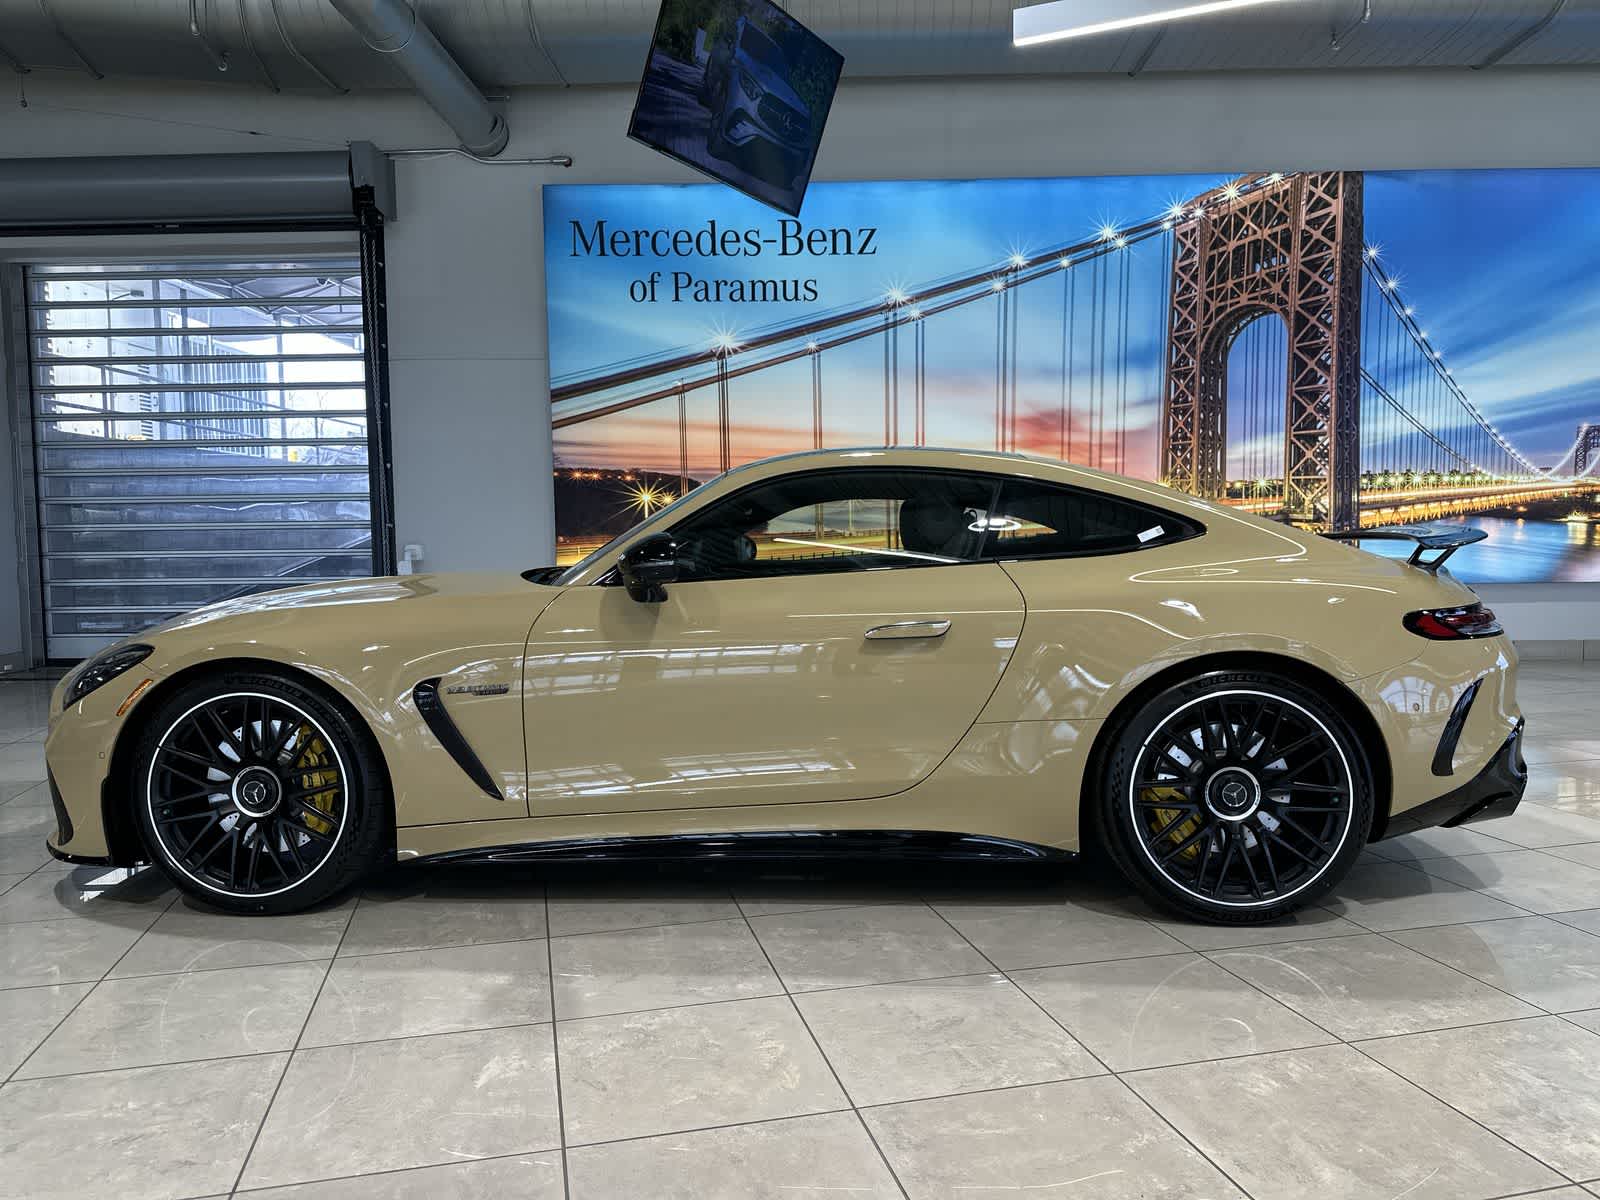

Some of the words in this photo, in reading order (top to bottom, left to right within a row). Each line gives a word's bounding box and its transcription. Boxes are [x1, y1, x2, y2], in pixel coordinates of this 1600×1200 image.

[569, 219, 877, 257] Mercedes-Benz
[629, 271, 660, 303] of
[672, 271, 818, 303] Paramus
